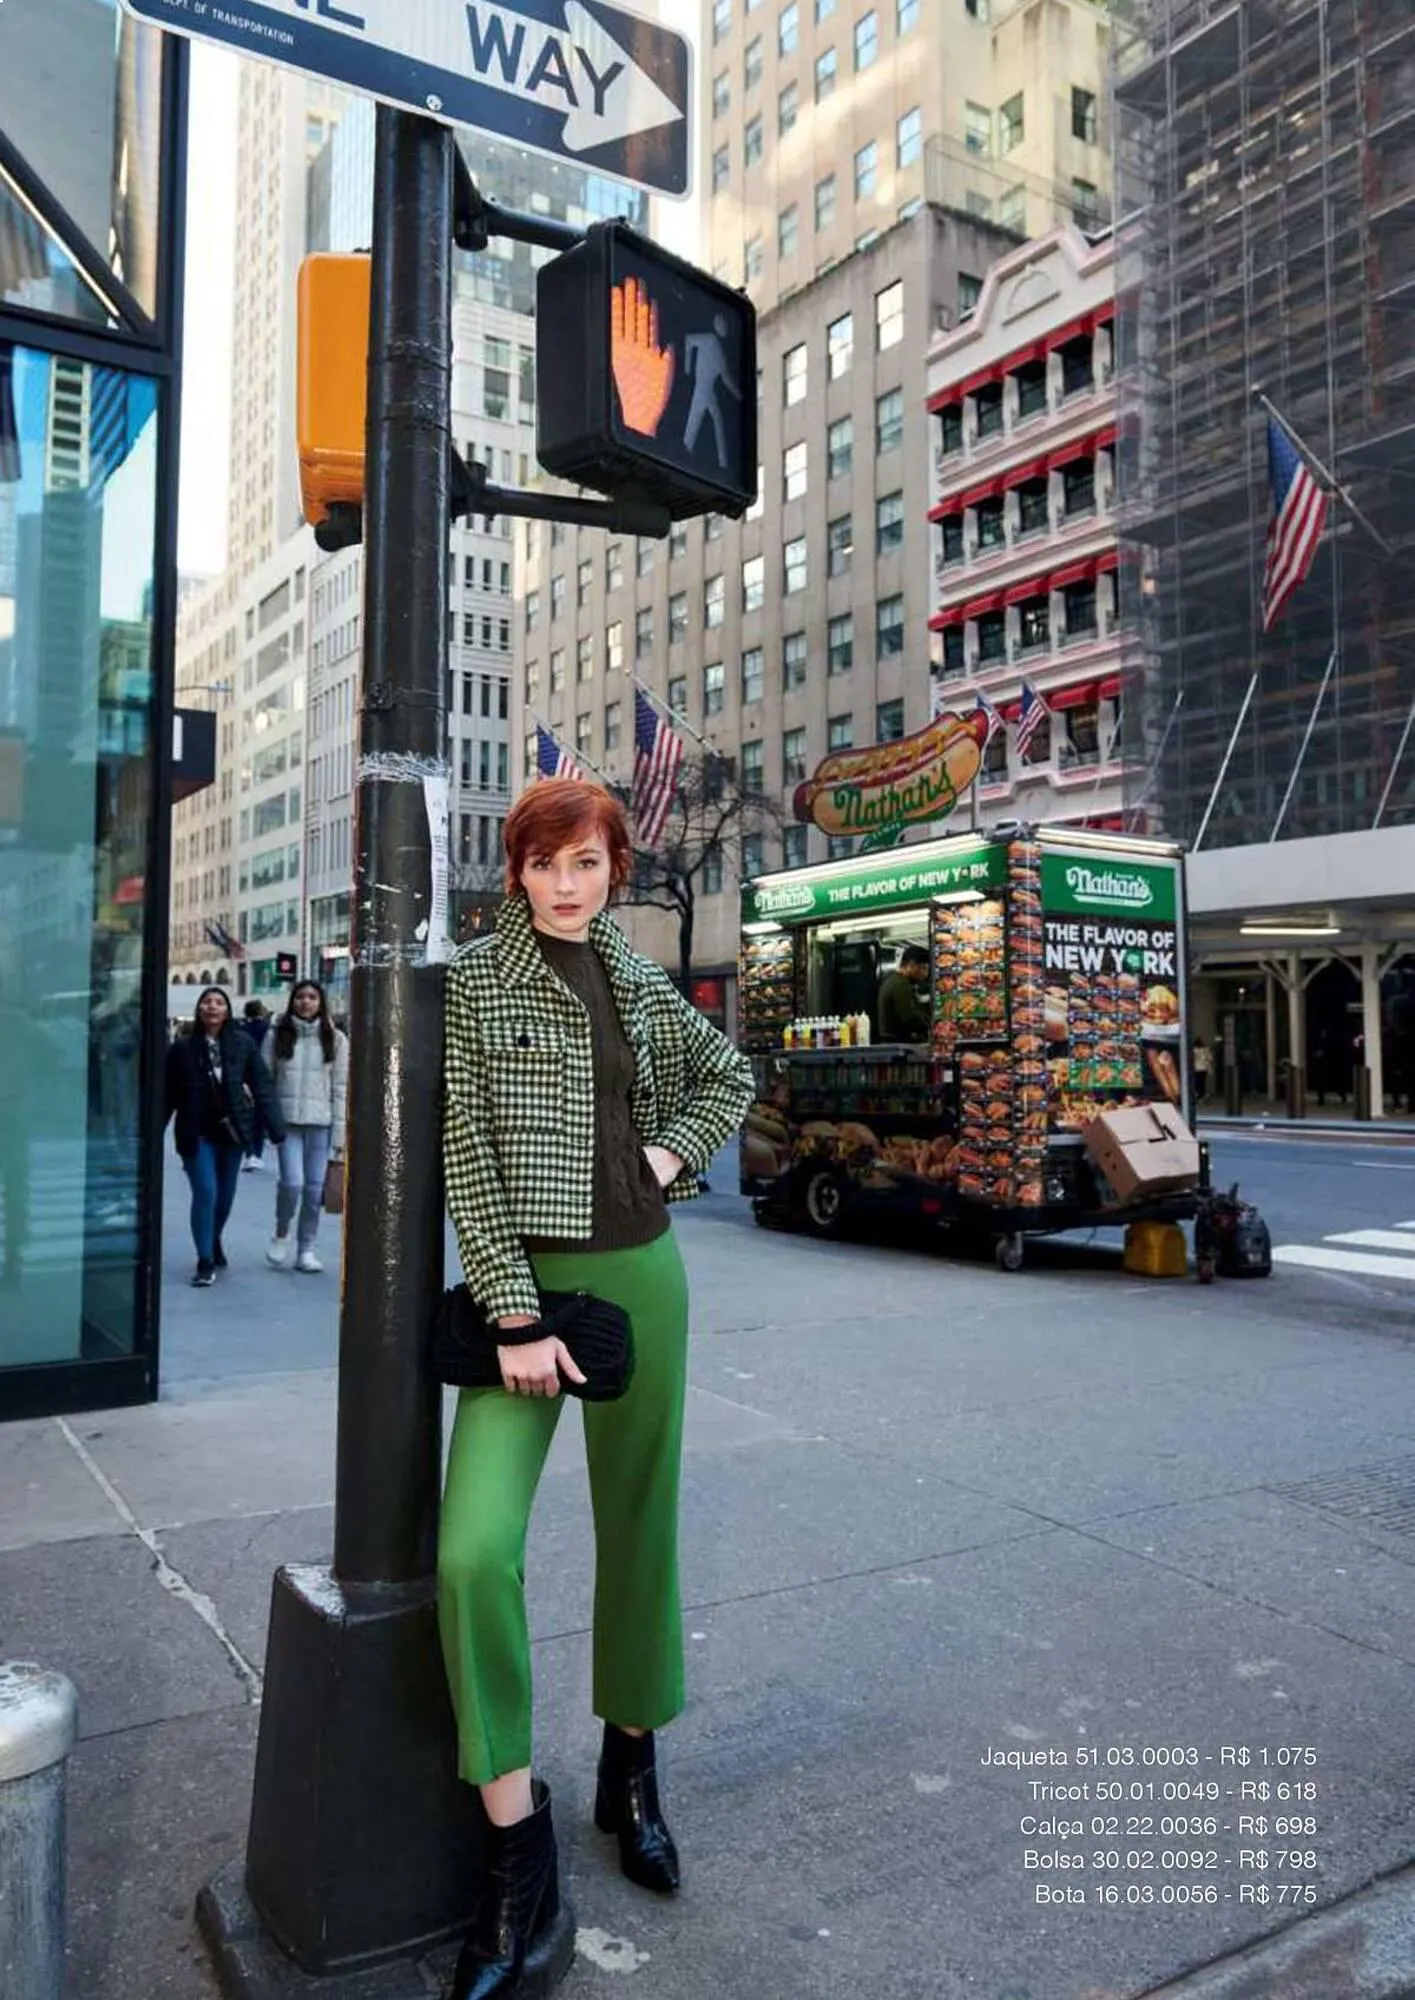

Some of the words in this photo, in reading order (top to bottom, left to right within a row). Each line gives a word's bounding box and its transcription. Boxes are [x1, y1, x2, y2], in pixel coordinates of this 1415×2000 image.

[194, 2, 207, 15] OF
[212, 9, 294, 45] TRANSPORTATION
[466, 4, 625, 117] WAY
[833, 760, 955, 828] Nathan's
[828, 888, 850, 903] THE
[852, 879, 897, 899] FLAVOR
[899, 876, 916, 890] OF
[919, 870, 949, 888] NEW
[952, 863, 989, 882] YRK
[1045, 922, 1080, 942] THE
[1083, 925, 1149, 947] FLAVOR
[1152, 931, 1174, 949] OF
[1045, 944, 1104, 972] NEW
[1110, 947, 1174, 976] YRK
